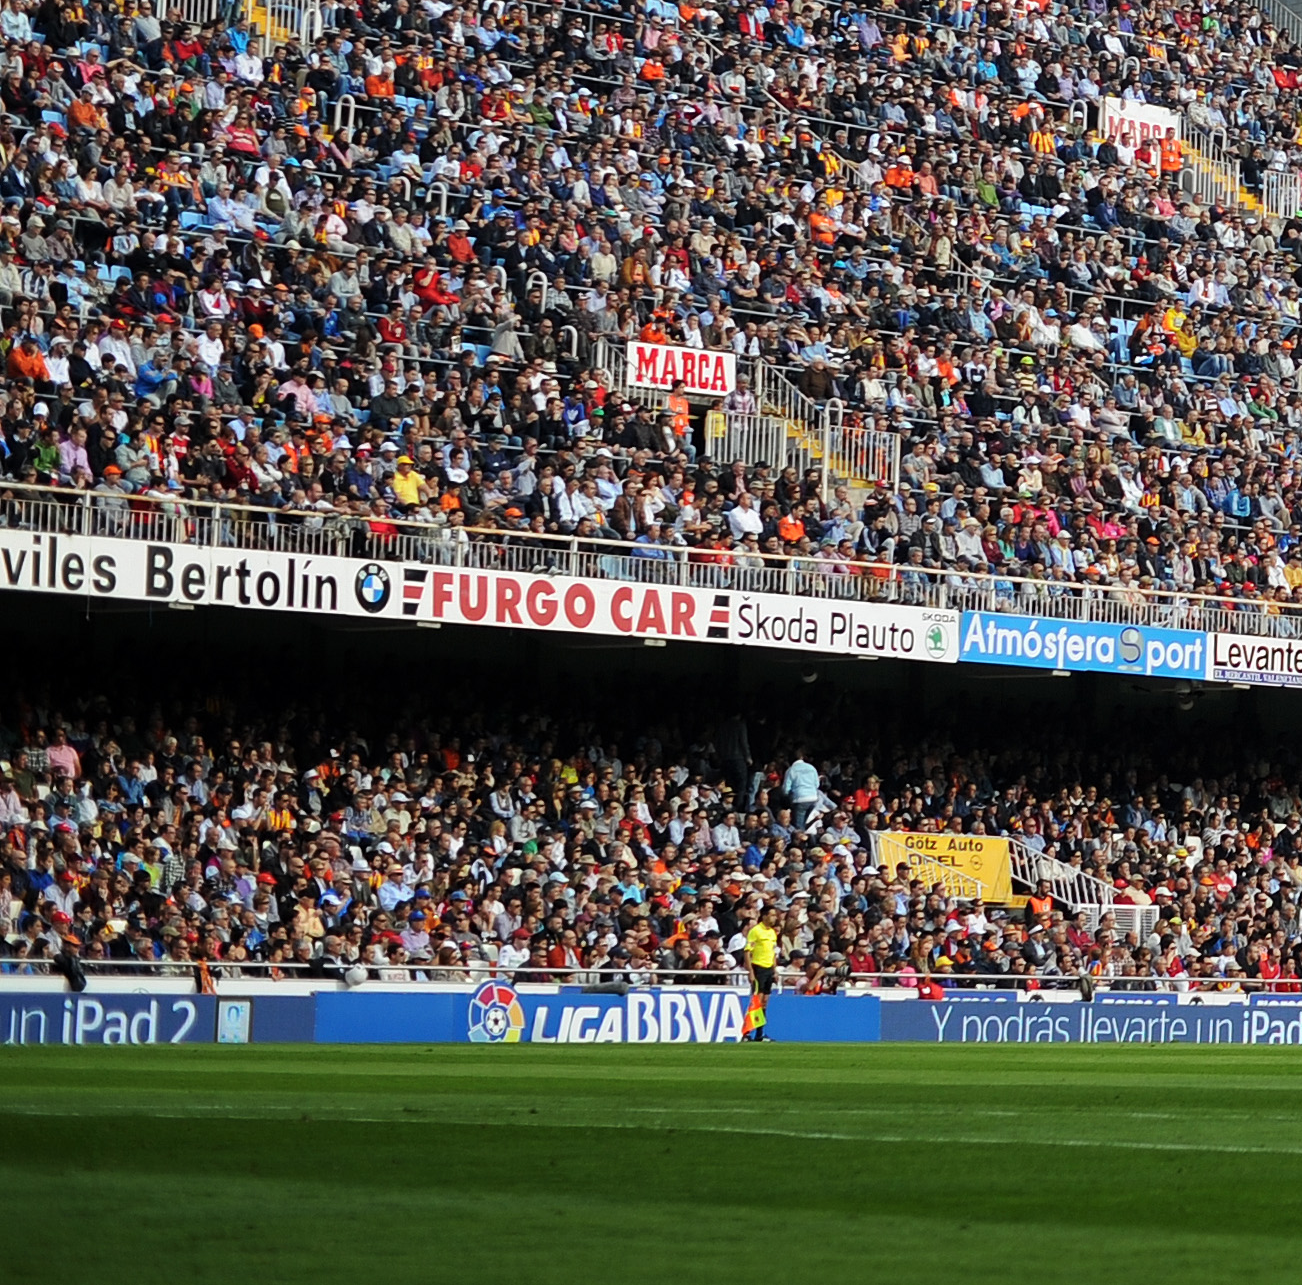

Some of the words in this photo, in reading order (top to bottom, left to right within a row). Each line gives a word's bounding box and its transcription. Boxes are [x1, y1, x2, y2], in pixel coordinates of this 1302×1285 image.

[637, 347, 727, 391] MARCA
[145, 544, 338, 612] Bertolín
[432, 570, 596, 629] FURGO
[610, 586, 698, 638] CAR
[737, 595, 819, 644] Škoda
[830, 612, 914, 653] Plauto
[963, 613, 1115, 669] Atmósfera
[905, 836, 937, 850] Götz
[947, 839, 983, 852] Auto
[63, 998, 157, 1045] iPad
[171, 1001, 196, 1044] 2
[532, 1006, 622, 1043] LIGA
[627, 993, 745, 1043] BBVA
[931, 1005, 953, 1043] Y
[1080, 1008, 1187, 1043] llevarte
